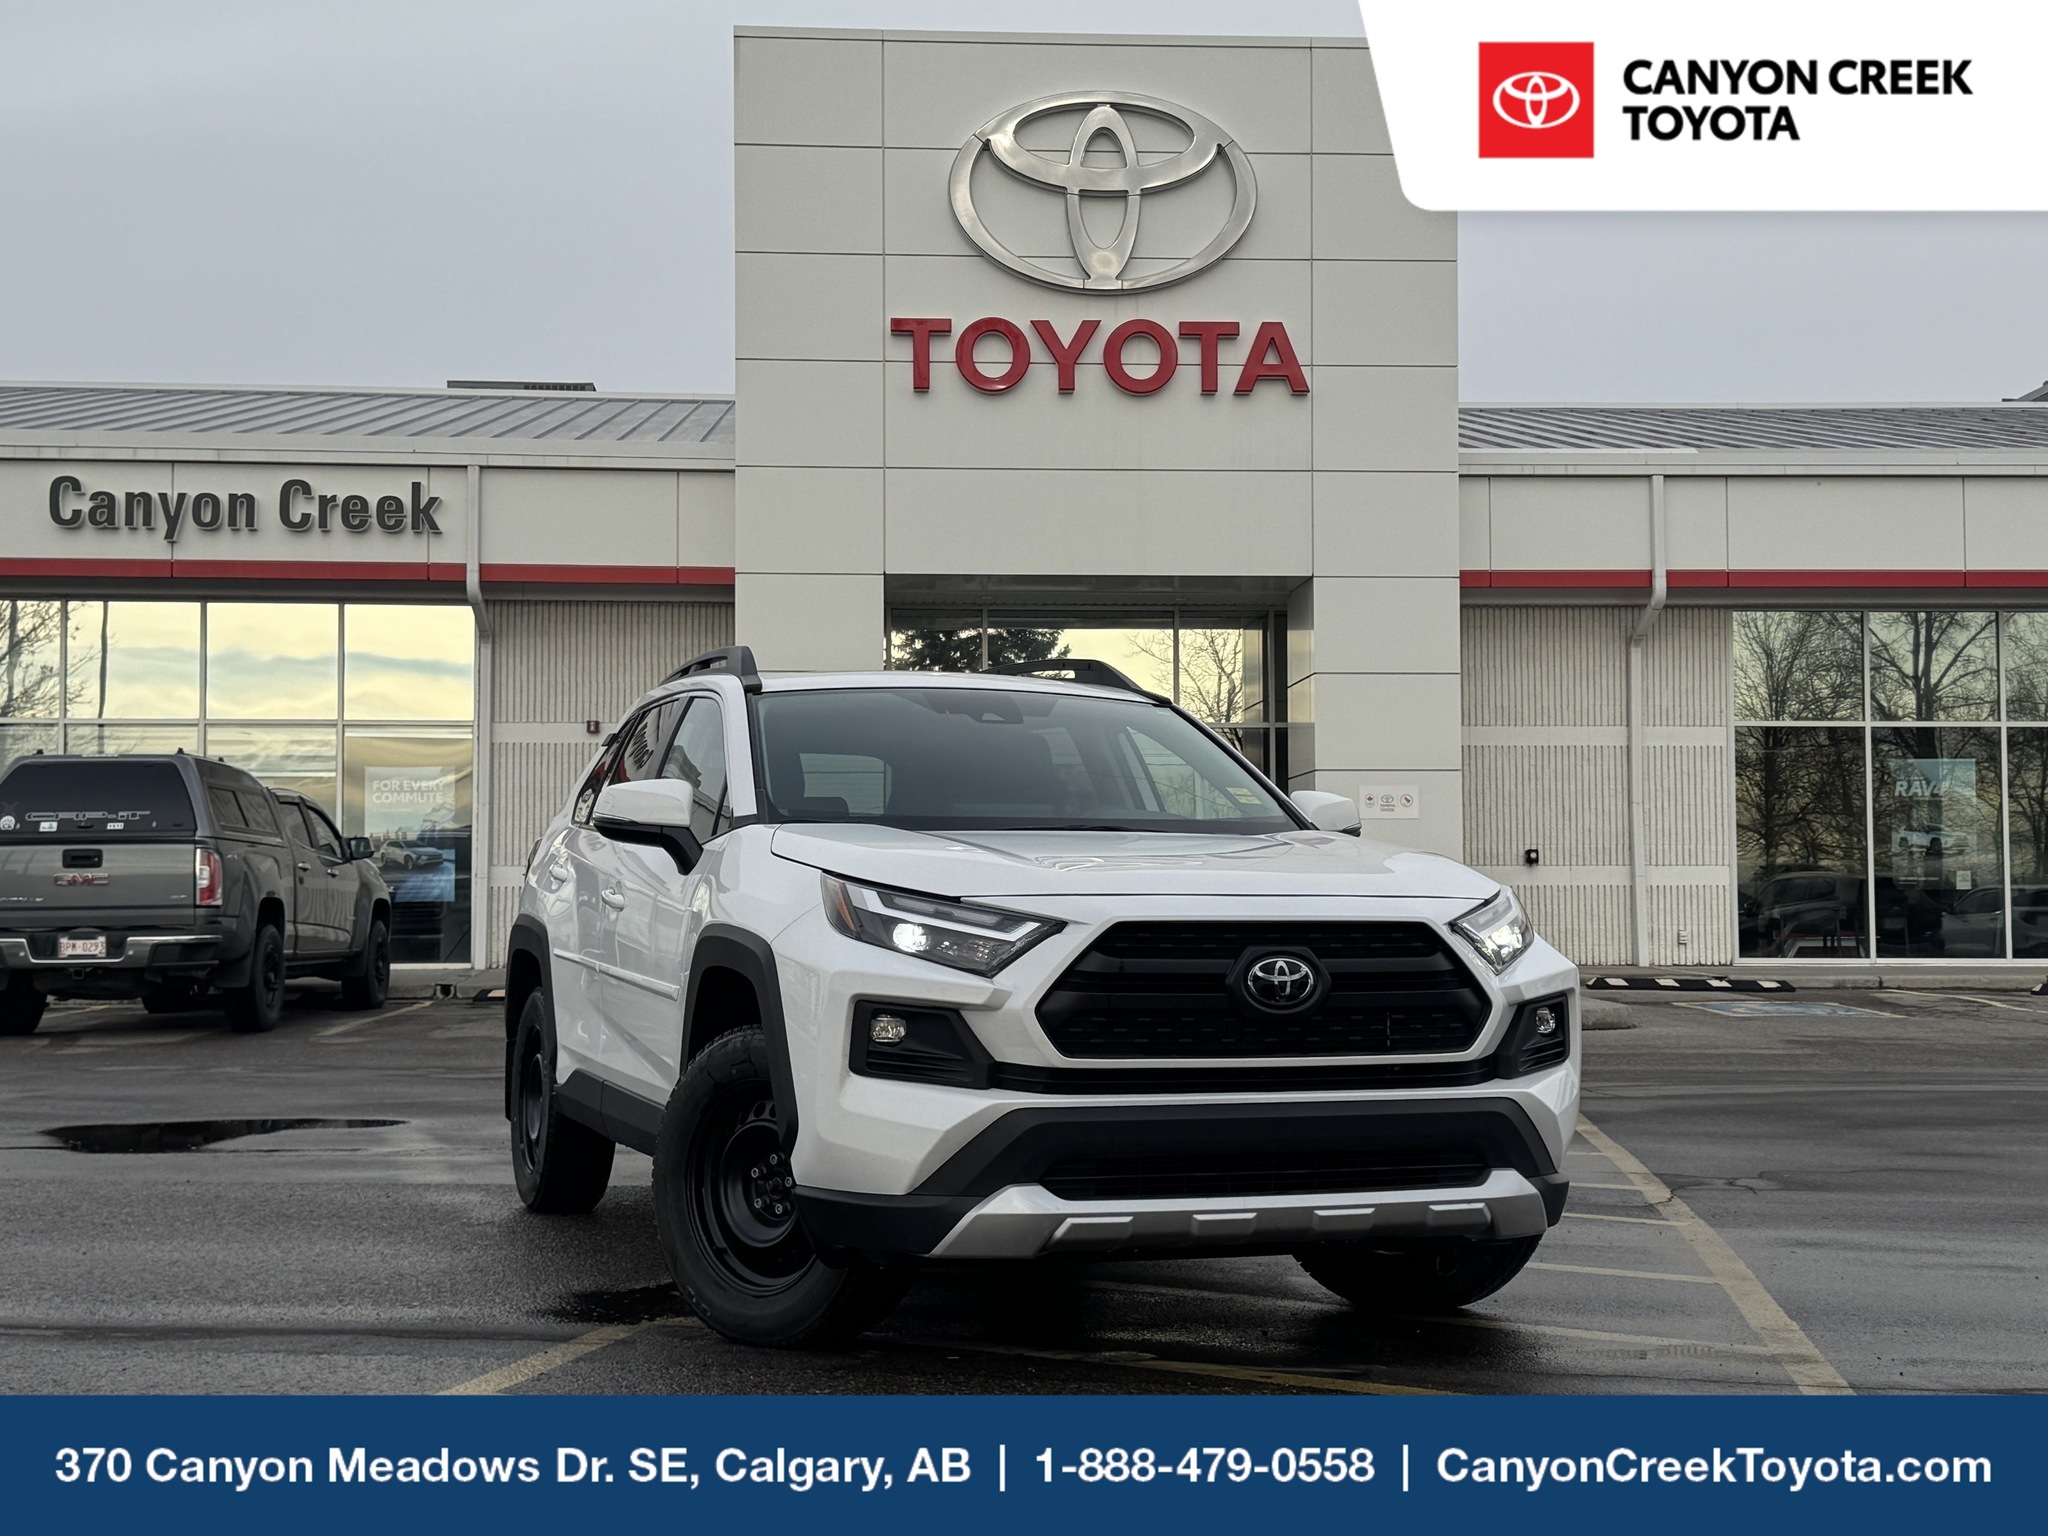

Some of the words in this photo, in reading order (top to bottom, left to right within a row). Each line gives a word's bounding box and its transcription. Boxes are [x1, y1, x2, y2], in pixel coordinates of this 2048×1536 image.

[891, 317, 1309, 395] TOYOTA
[49, 475, 257, 541] Canyon
[279, 478, 442, 533] Creek
[372, 780, 400, 791] FOR
[403, 780, 445, 791] EVERY
[1894, 780, 1948, 797] RAV4
[372, 792, 444, 804] COMMUTE
[54, 873, 109, 886] GMC
